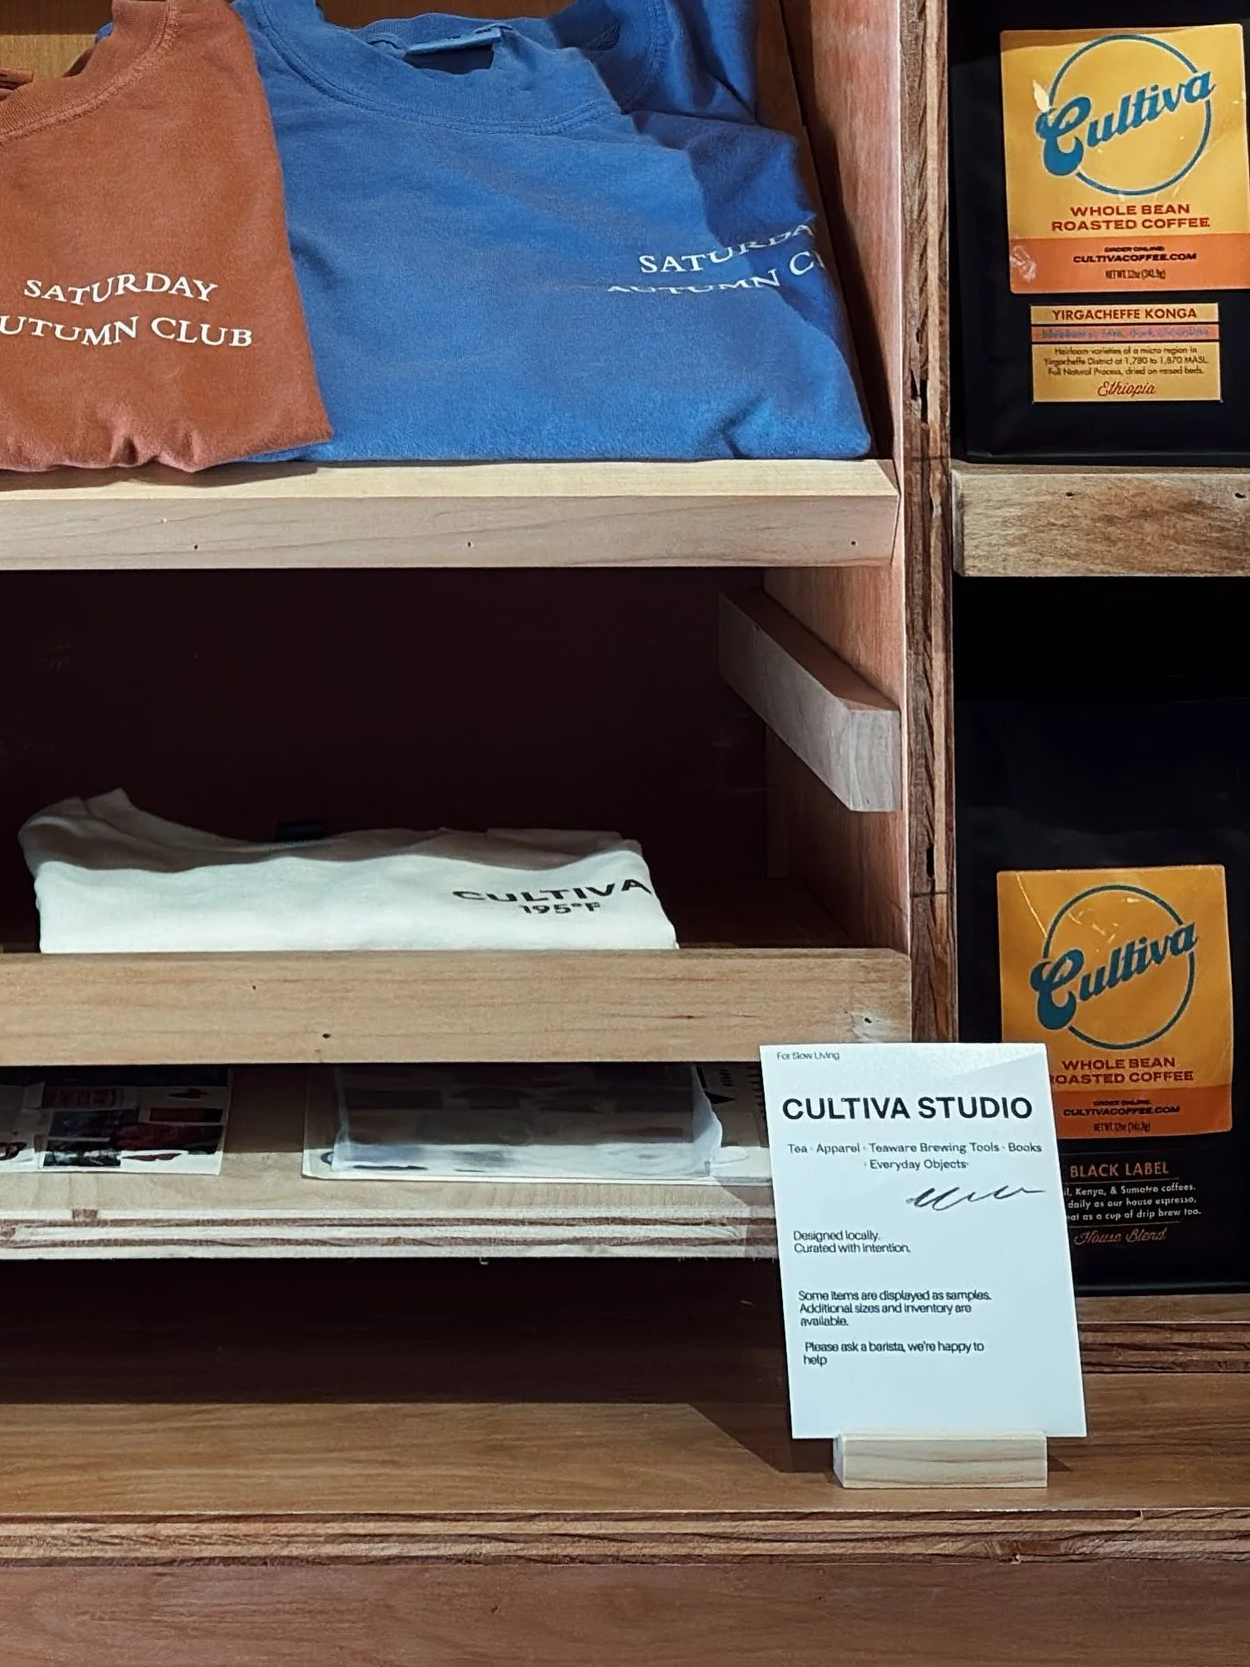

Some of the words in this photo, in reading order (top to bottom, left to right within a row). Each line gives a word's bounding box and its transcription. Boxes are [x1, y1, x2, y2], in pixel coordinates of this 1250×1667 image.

[1035, 71, 1217, 177] Cultiva
[1070, 205, 1138, 217] WHOLE
[1141, 204, 1190, 215] BEAN
[1051, 219, 1138, 232] ROASTED
[1141, 217, 1211, 230] COFFEE
[1073, 253, 1197, 264] CULTIVACOFFEE.COM
[608, 268, 781, 295] AUTUMN
[23, 271, 219, 307] SATURDAY
[1052, 308, 1141, 321] YIRGACHEFFE
[1144, 307, 1197, 320] KONGA
[150, 316, 253, 348] CLUB
[1097, 380, 1156, 398] Ethiopia
[452, 878, 652, 903] CULTIVA
[518, 901, 602, 915] 195°F
[1030, 921, 1199, 1031] Cultiva
[776, 1052, 791, 1060] For
[791, 1052, 813, 1060] Slow
[813, 1051, 840, 1061] Living
[1061, 1059, 1125, 1071] WHOLE
[1128, 1057, 1176, 1069] BEAN
[1128, 1071, 1194, 1083] COFFEE
[781, 1097, 911, 1120] CULTIVA
[917, 1096, 1033, 1119] STUDIO
[1062, 1106, 1181, 1117] CULTIVACOFFEE.COM
[787, 1144, 808, 1154] Tea
[816, 1143, 861, 1155] Apparel
[868, 1142, 918, 1153] Teaware
[919, 1142, 967, 1155] Brewing
[968, 1142, 1000, 1153] Tools
[1008, 1142, 1042, 1153] Books
[869, 1159, 921, 1172] Everyday
[923, 1159, 966, 1171] Objects
[1069, 1163, 1119, 1178] BLACK
[1125, 1161, 1169, 1176] LABEL
[1075, 1187, 1107, 1198] Kenya,
[1110, 1186, 1117, 1195] &
[1120, 1185, 1159, 1195] Sumatra
[1161, 1183, 1197, 1193] coffees.
[1067, 1200, 1091, 1211] daily
[1107, 1200, 1123, 1208] our
[1126, 1197, 1153, 1207] house
[1105, 1213, 1121, 1221] cup
[1124, 1209, 1134, 1219] of
[1136, 1209, 1156, 1219] drip
[1158, 1207, 1181, 1217] brew
[1183, 1207, 1202, 1216] too.
[793, 1230, 844, 1242] Designed
[844, 1229, 881, 1242] locally.
[1073, 1230, 1122, 1246] House
[1125, 1226, 1168, 1243] Blend
[793, 1242, 837, 1253] Curated
[837, 1242, 861, 1253] with
[861, 1242, 912, 1253] intention.
[798, 1290, 829, 1301] Some
[830, 1290, 859, 1301] items
[861, 1292, 878, 1301] are
[879, 1290, 930, 1303] displayed
[932, 1292, 945, 1301] as
[945, 1290, 992, 1302] samples.
[799, 1303, 854, 1314] Additional
[854, 1303, 880, 1314] sizes
[881, 1303, 903, 1314] and
[904, 1303, 953, 1316] inventory
[954, 1304, 972, 1313] are
[800, 1316, 849, 1327] available.
[804, 1341, 839, 1352] Please
[840, 1341, 859, 1352] ask
[860, 1343, 868, 1352] a
[868, 1341, 906, 1353] barista,
[906, 1341, 937, 1352] we're
[937, 1341, 972, 1354] happy
[973, 1341, 985, 1352] to
[803, 1354, 828, 1367] help
